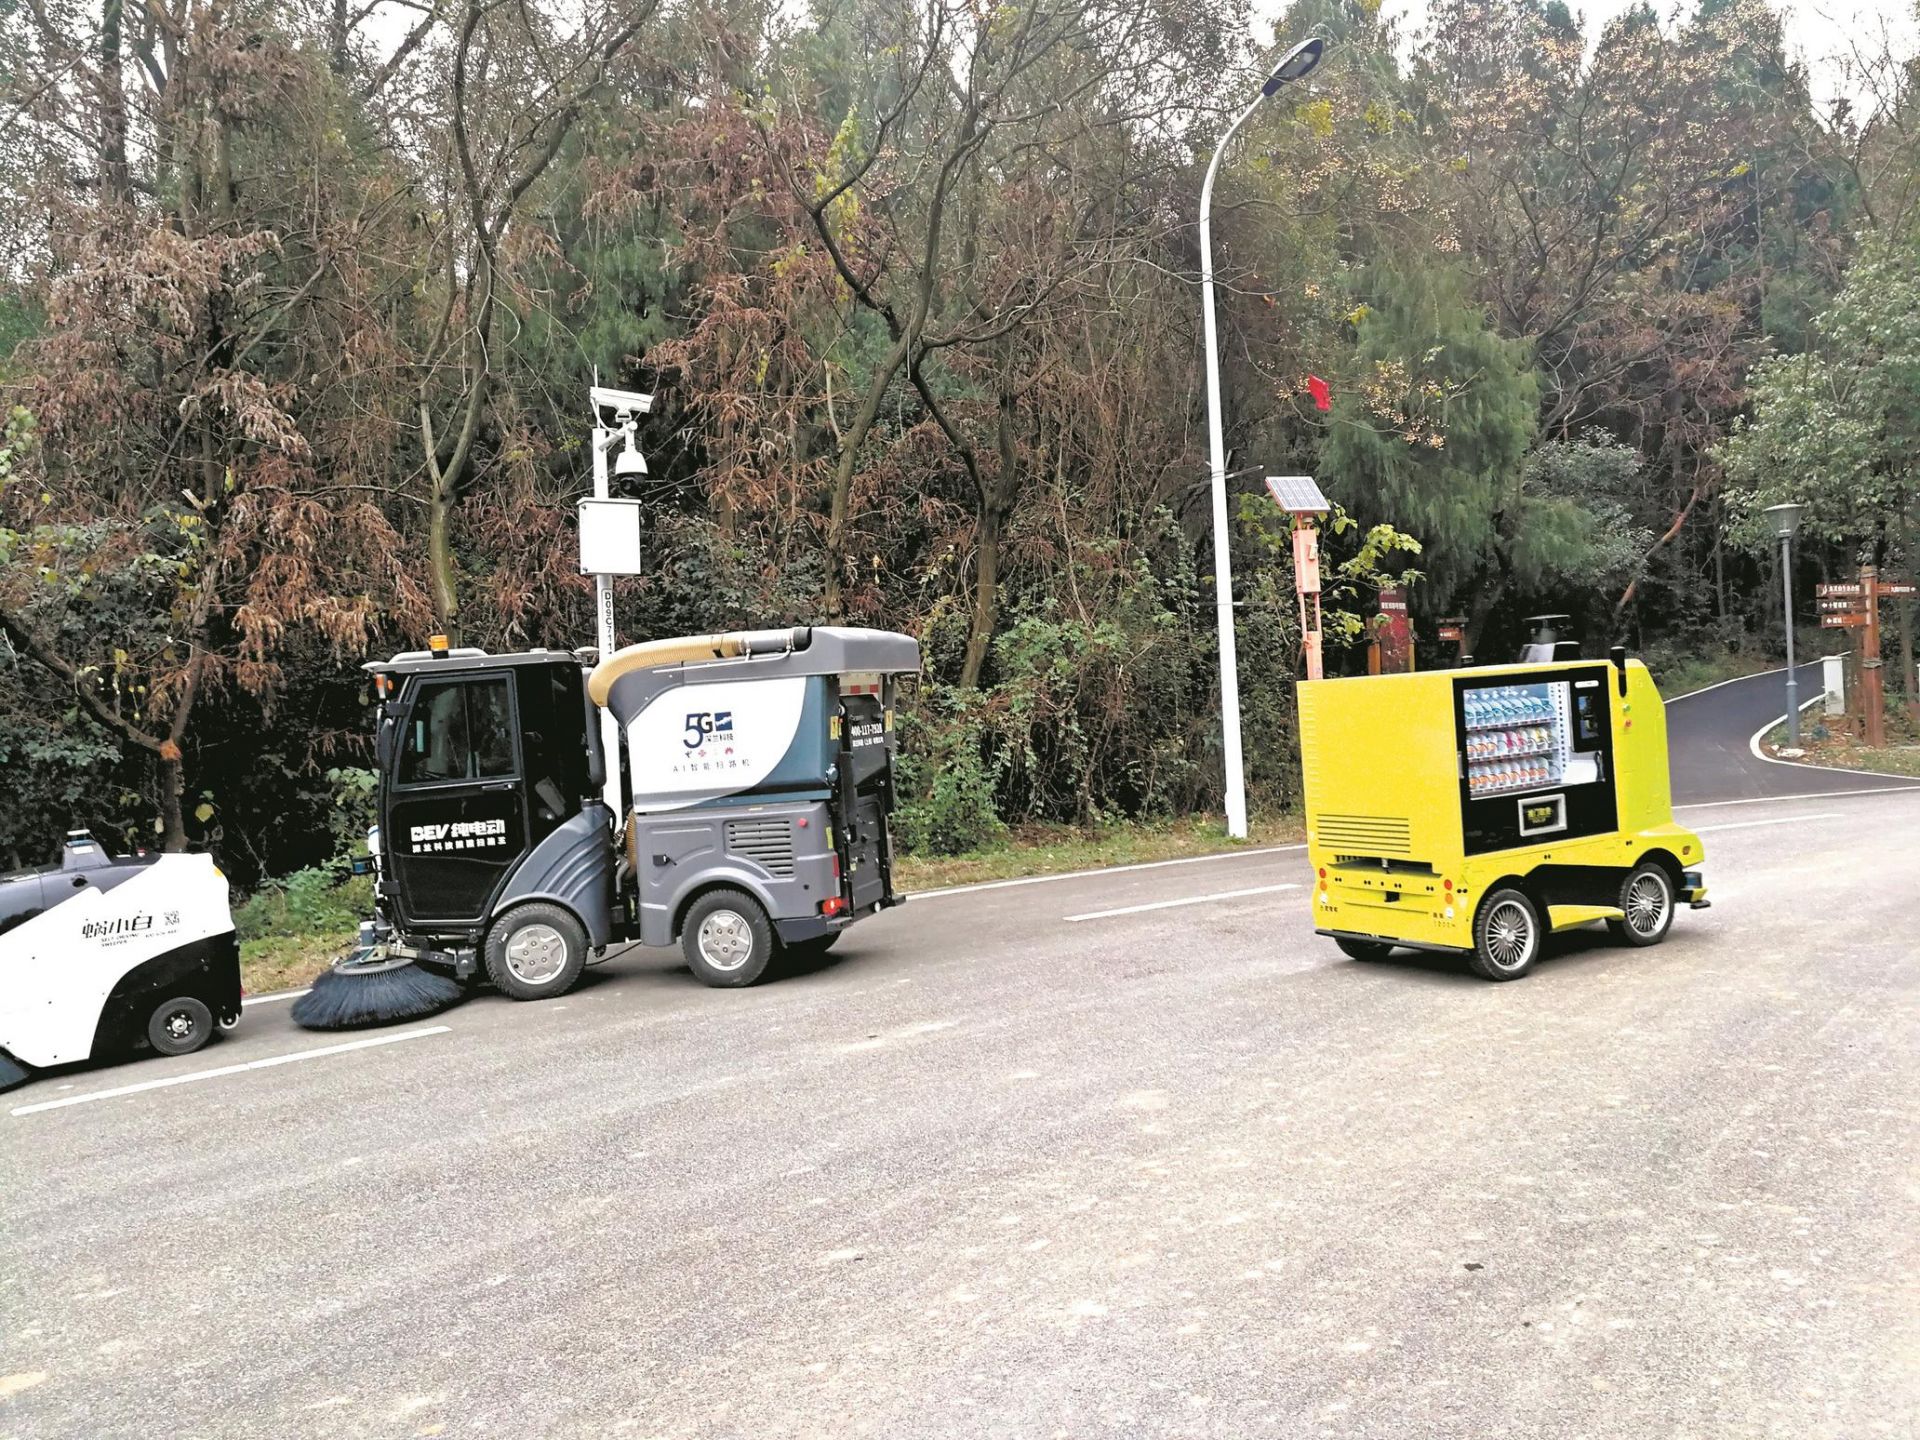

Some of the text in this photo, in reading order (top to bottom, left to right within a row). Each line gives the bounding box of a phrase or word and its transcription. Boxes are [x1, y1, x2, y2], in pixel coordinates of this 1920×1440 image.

[604, 591, 613, 655] D09C711
[683, 712, 713, 749] 5G
[451, 819, 506, 838] 纯电动
[82, 915, 153, 938] 蜗小白
